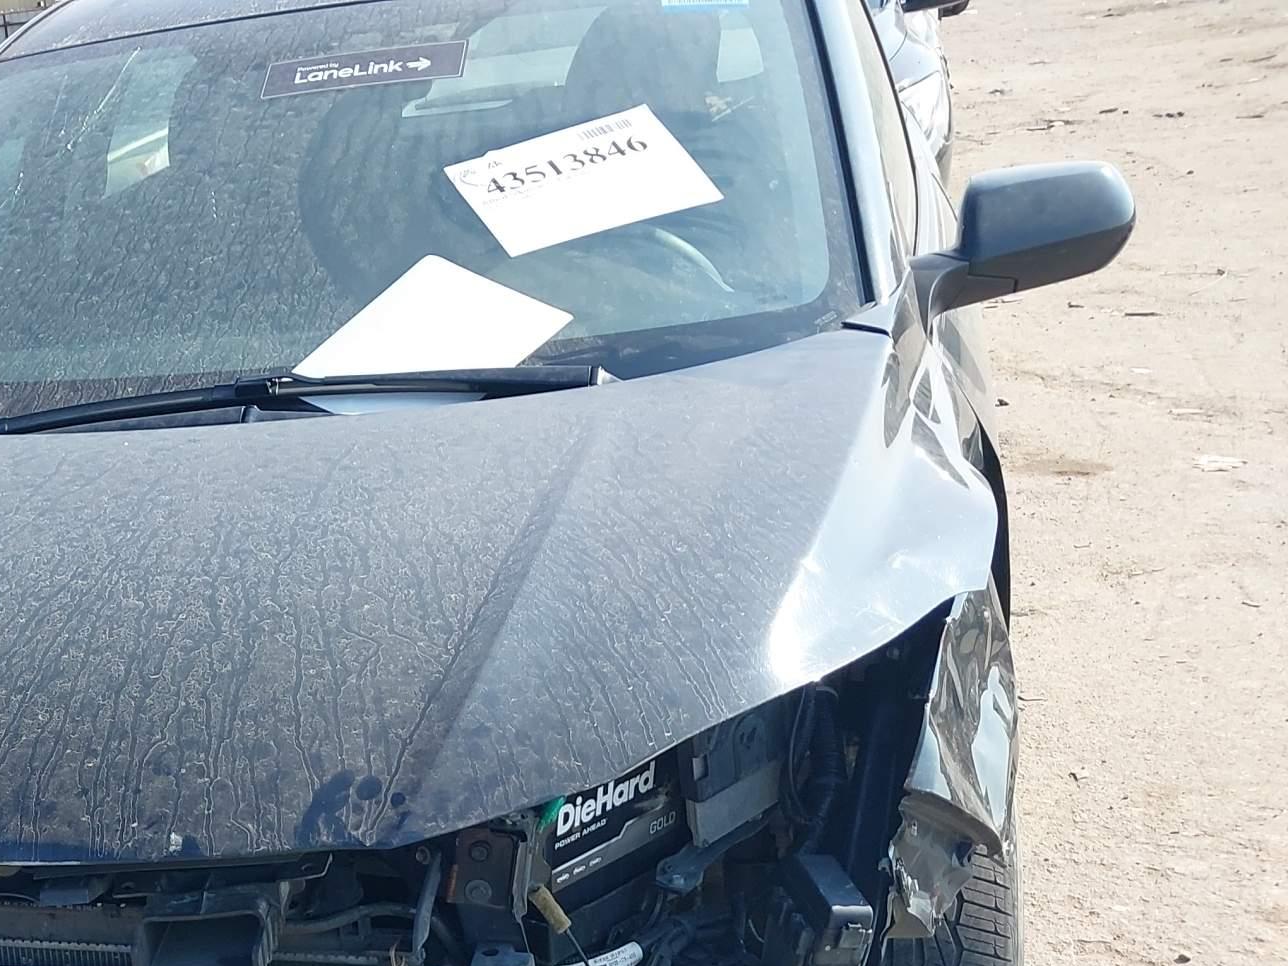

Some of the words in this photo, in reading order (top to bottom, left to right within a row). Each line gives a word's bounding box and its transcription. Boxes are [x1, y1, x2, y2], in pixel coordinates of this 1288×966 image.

[293, 60, 404, 85] LaneLink
[487, 136, 648, 194] 43513846
[556, 760, 656, 837] DieHard
[555, 833, 581, 851] POWER
[582, 819, 607, 837] AHEAD
[650, 811, 676, 834] GOLD
